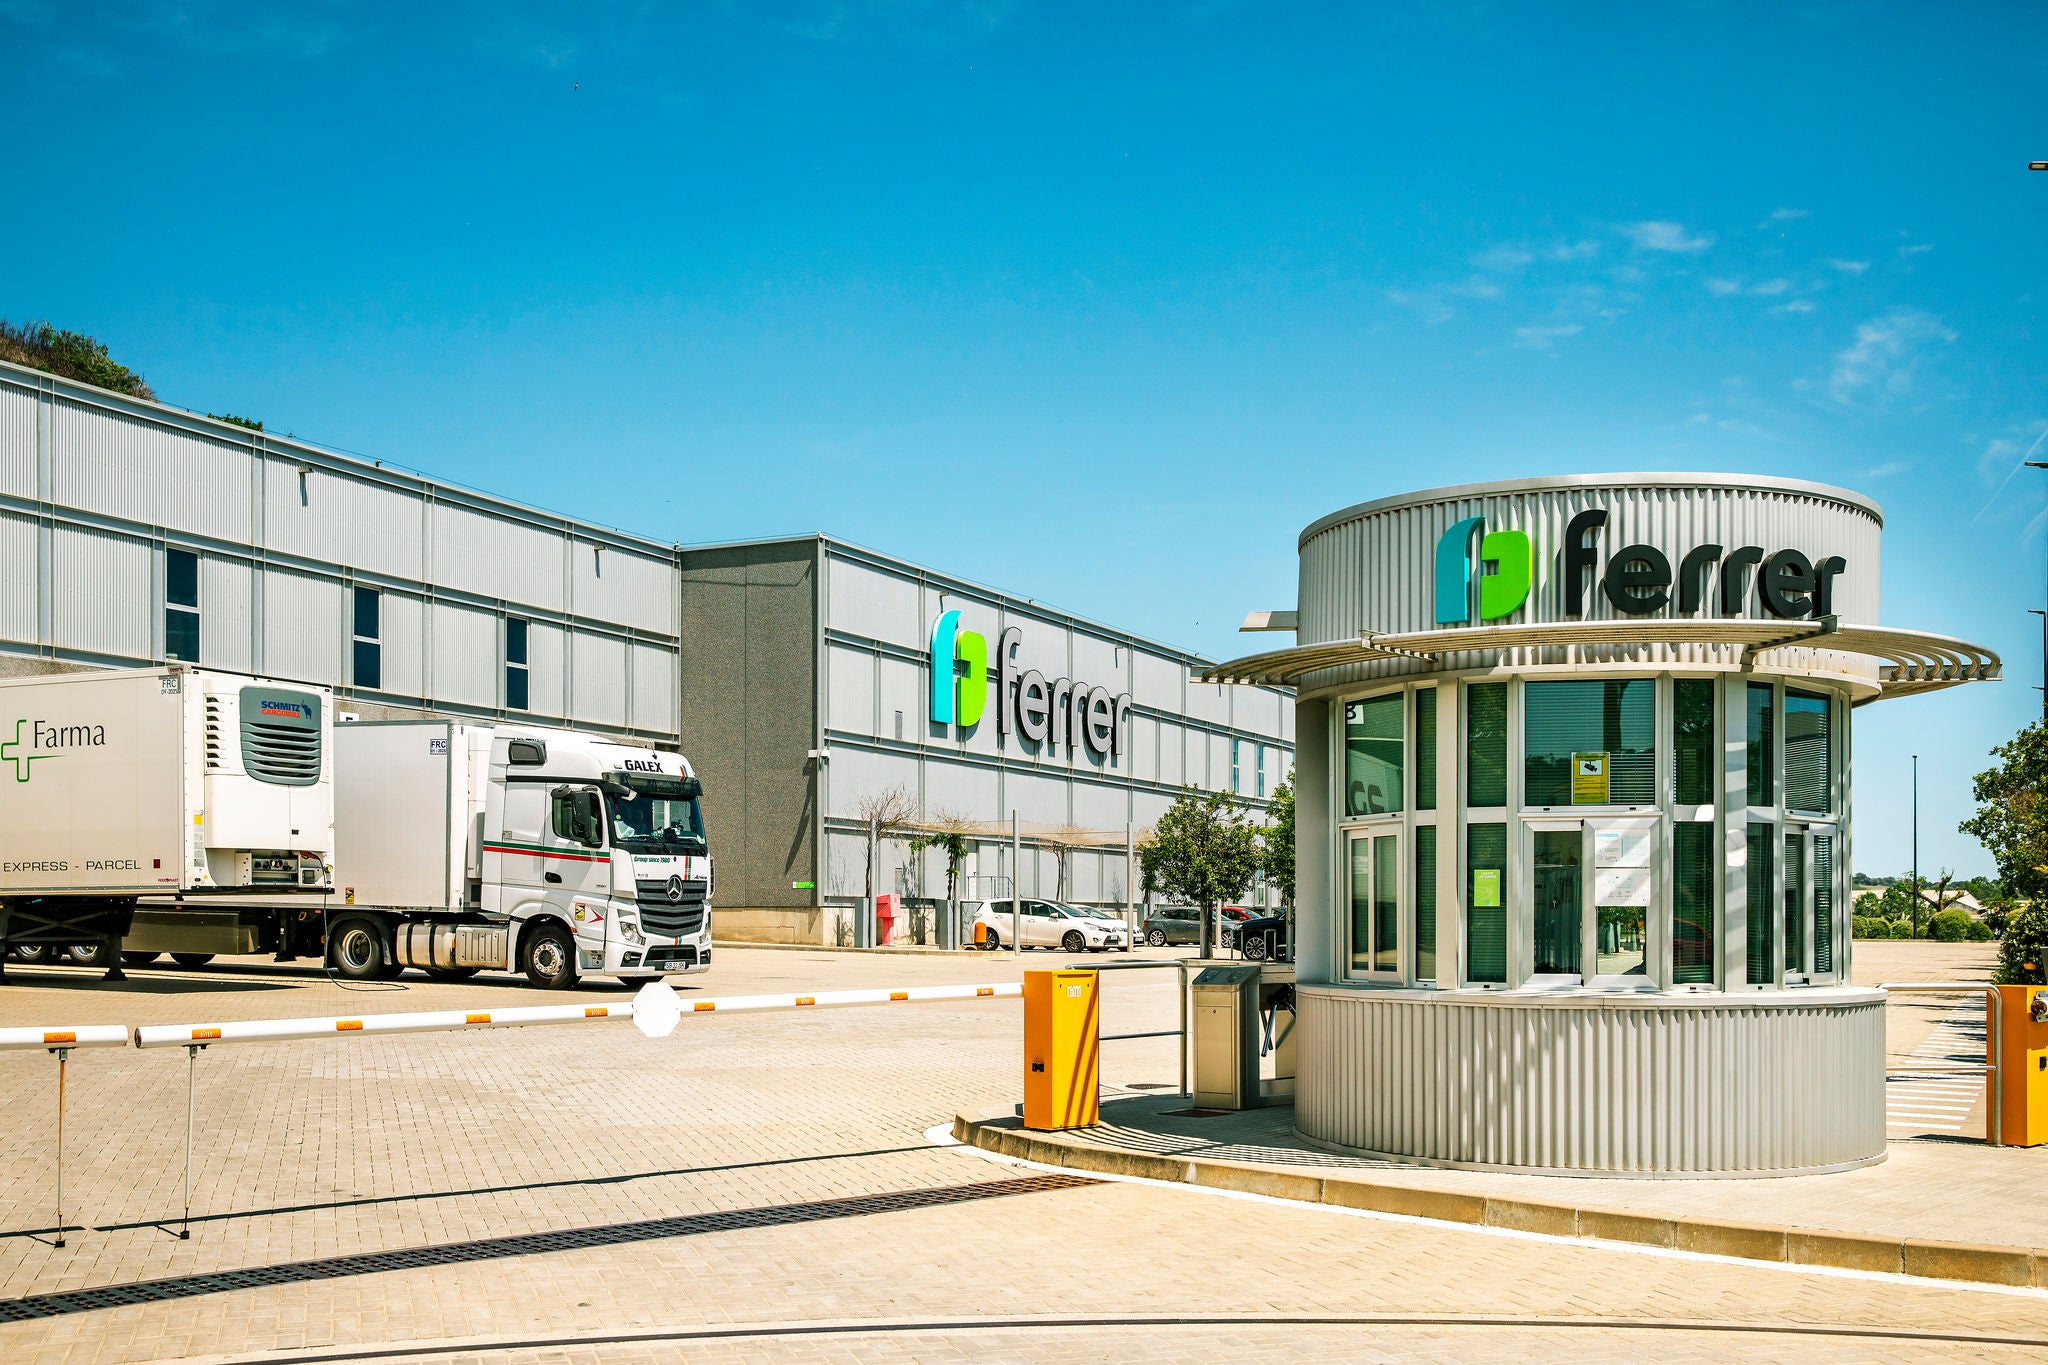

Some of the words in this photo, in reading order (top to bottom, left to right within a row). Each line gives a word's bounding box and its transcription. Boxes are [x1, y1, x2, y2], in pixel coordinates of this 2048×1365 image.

[1565, 509, 1847, 619] ferrer
[162, 679, 176, 688] FRC
[997, 626, 1133, 756] ferrer
[261, 700, 300, 712] SCHMITZ
[33, 720, 106, 748] Farma
[430, 740, 446, 748] FRC
[624, 759, 664, 773] GALEX
[3, 861, 68, 872] EXPRESS
[86, 859, 141, 871] PARCEL
